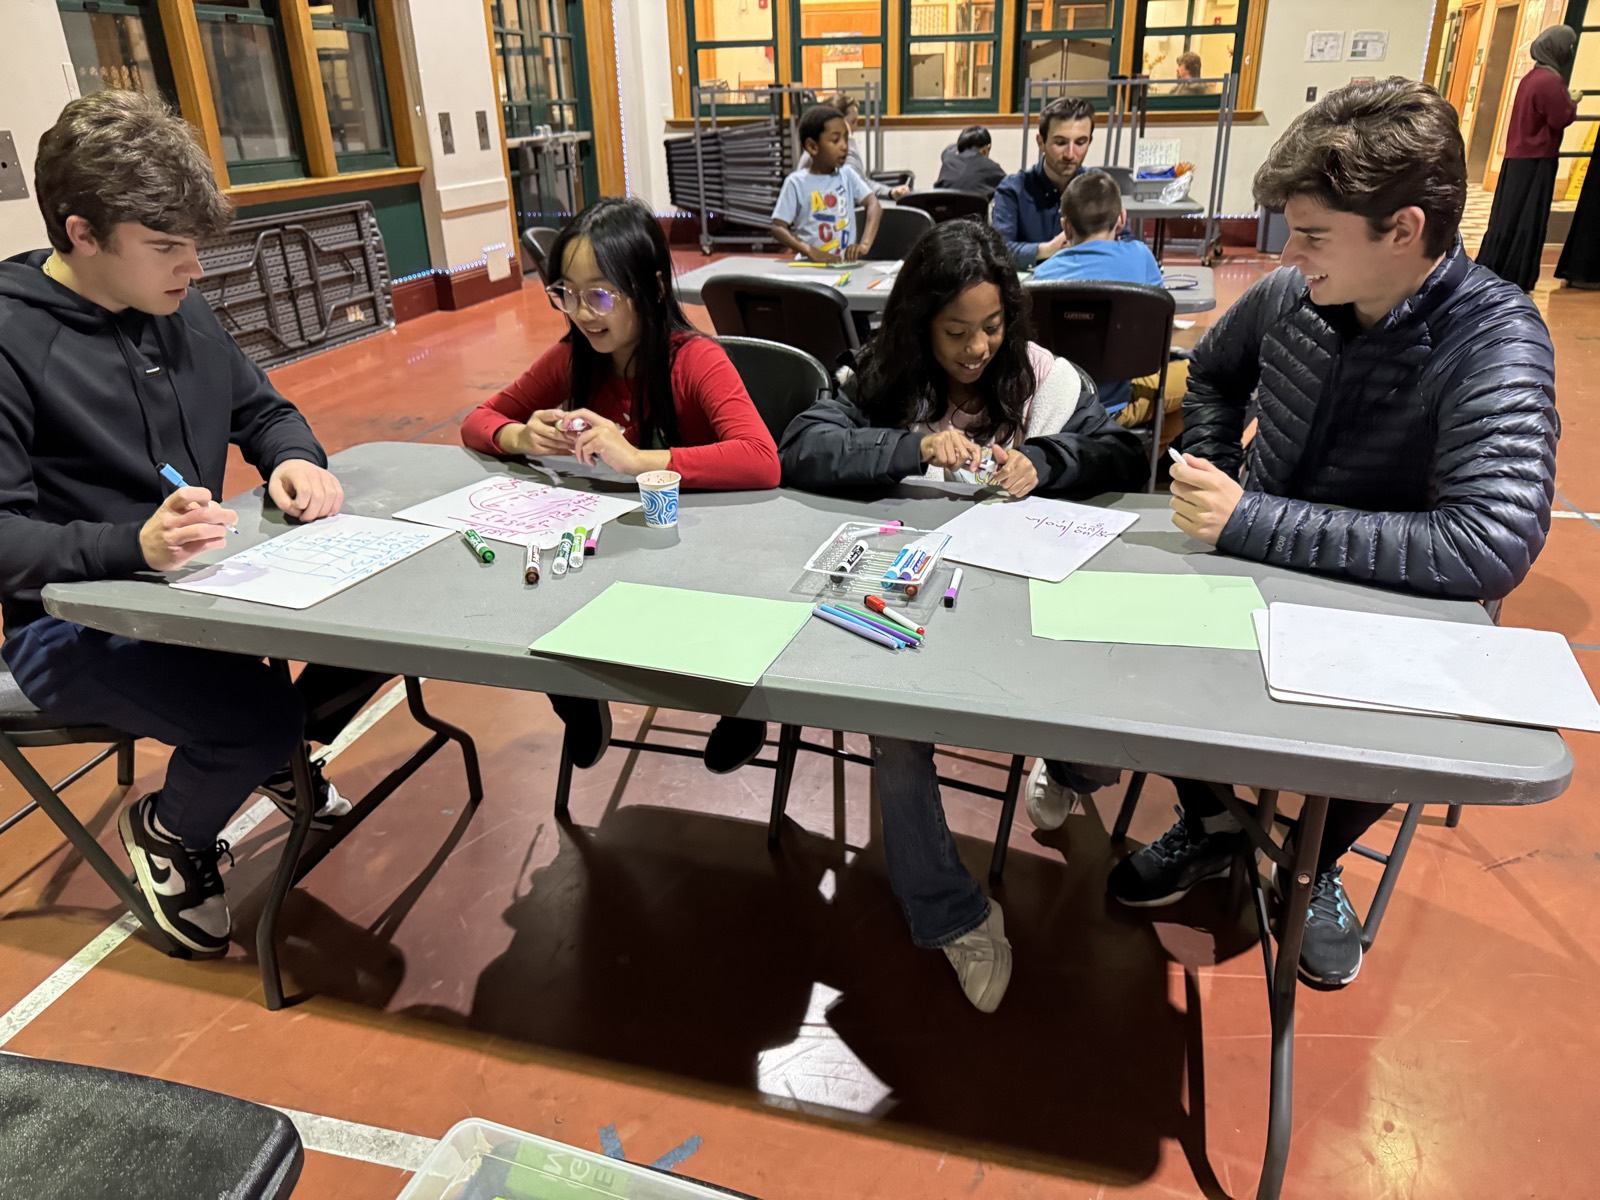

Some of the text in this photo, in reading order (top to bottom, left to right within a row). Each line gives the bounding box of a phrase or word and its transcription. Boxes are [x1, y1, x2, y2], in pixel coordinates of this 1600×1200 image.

[812, 191, 847, 217] A B
[818, 222, 849, 249] C D
[1275, 535, 1286, 552] 800
